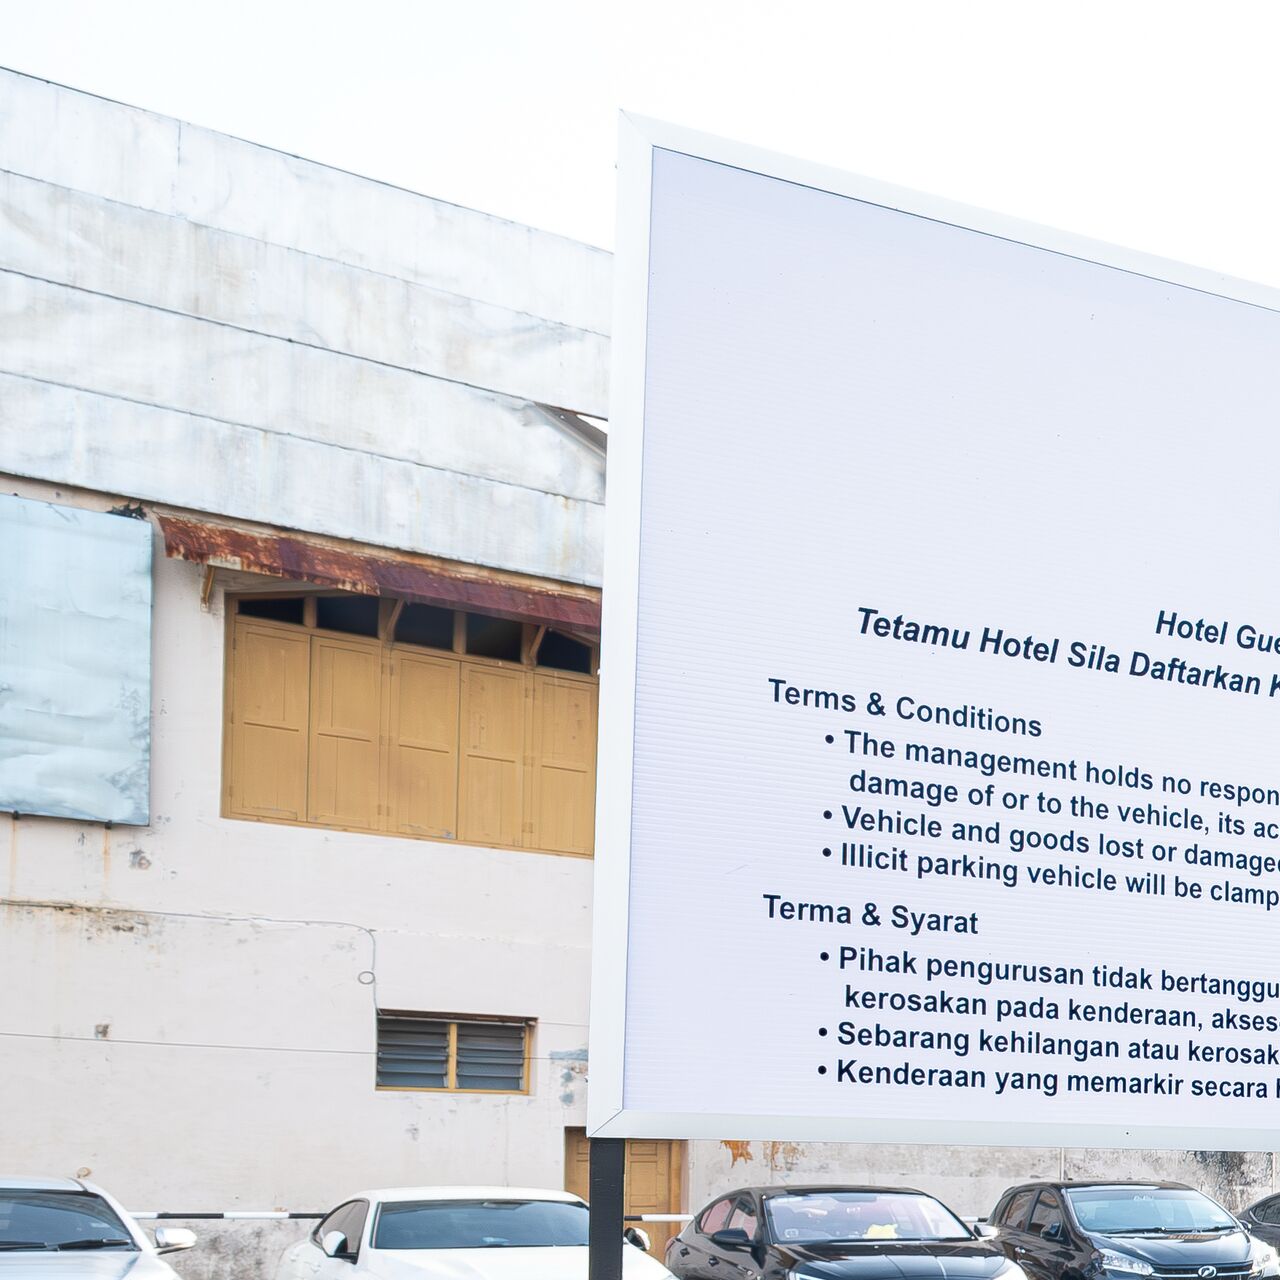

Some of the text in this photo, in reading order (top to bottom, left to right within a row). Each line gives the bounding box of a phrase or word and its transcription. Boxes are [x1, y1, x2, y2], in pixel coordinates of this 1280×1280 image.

[856, 606, 971, 650] Tetamu
[978, 626, 1060, 664] Hotel
[1066, 640, 1120, 674] Sila
[1128, 650, 1261, 695] Daftarkan
[1154, 609, 1228, 645] Hotel
[767, 677, 1042, 737] Terms & Conditions
[843, 728, 895, 758] The
[905, 742, 1077, 781] management
[1085, 759, 1153, 790] holds
[1161, 775, 1192, 795] no
[849, 768, 958, 807] damage
[967, 783, 995, 807] of
[1001, 791, 1030, 811] or
[1035, 790, 1062, 815] to
[1069, 794, 1109, 820] the
[1116, 802, 1209, 836] vehicle,
[1217, 810, 1245, 836] its
[841, 803, 942, 838] Vehicle
[950, 820, 1000, 844] and
[1008, 828, 1090, 854] goods
[1098, 832, 1144, 860] lost
[1151, 843, 1178, 862] or
[840, 841, 908, 872] Illicit
[916, 853, 1018, 888] parking
[1026, 862, 1117, 891] vehicle
[1124, 871, 1165, 896] will
[1173, 874, 1202, 899] be
[1209, 879, 1280, 911] clamp
[762, 892, 979, 936] Terma & Syarat
[838, 945, 917, 974] Pihak
[925, 957, 1084, 986] pengurusan
[1091, 963, 1153, 990] tidak
[844, 983, 987, 1016] kerosakan
[995, 995, 1059, 1022] pada
[1067, 997, 1203, 1032] kenderaan,
[836, 1020, 969, 1057] Sebarang
[978, 1027, 1119, 1062] kehilangan
[1127, 1037, 1179, 1061] atau
[836, 1058, 986, 1088] Kenderaan
[994, 1071, 1058, 1097] yang
[1066, 1071, 1184, 1095] memarkir
[1190, 1078, 1268, 1099] secara
